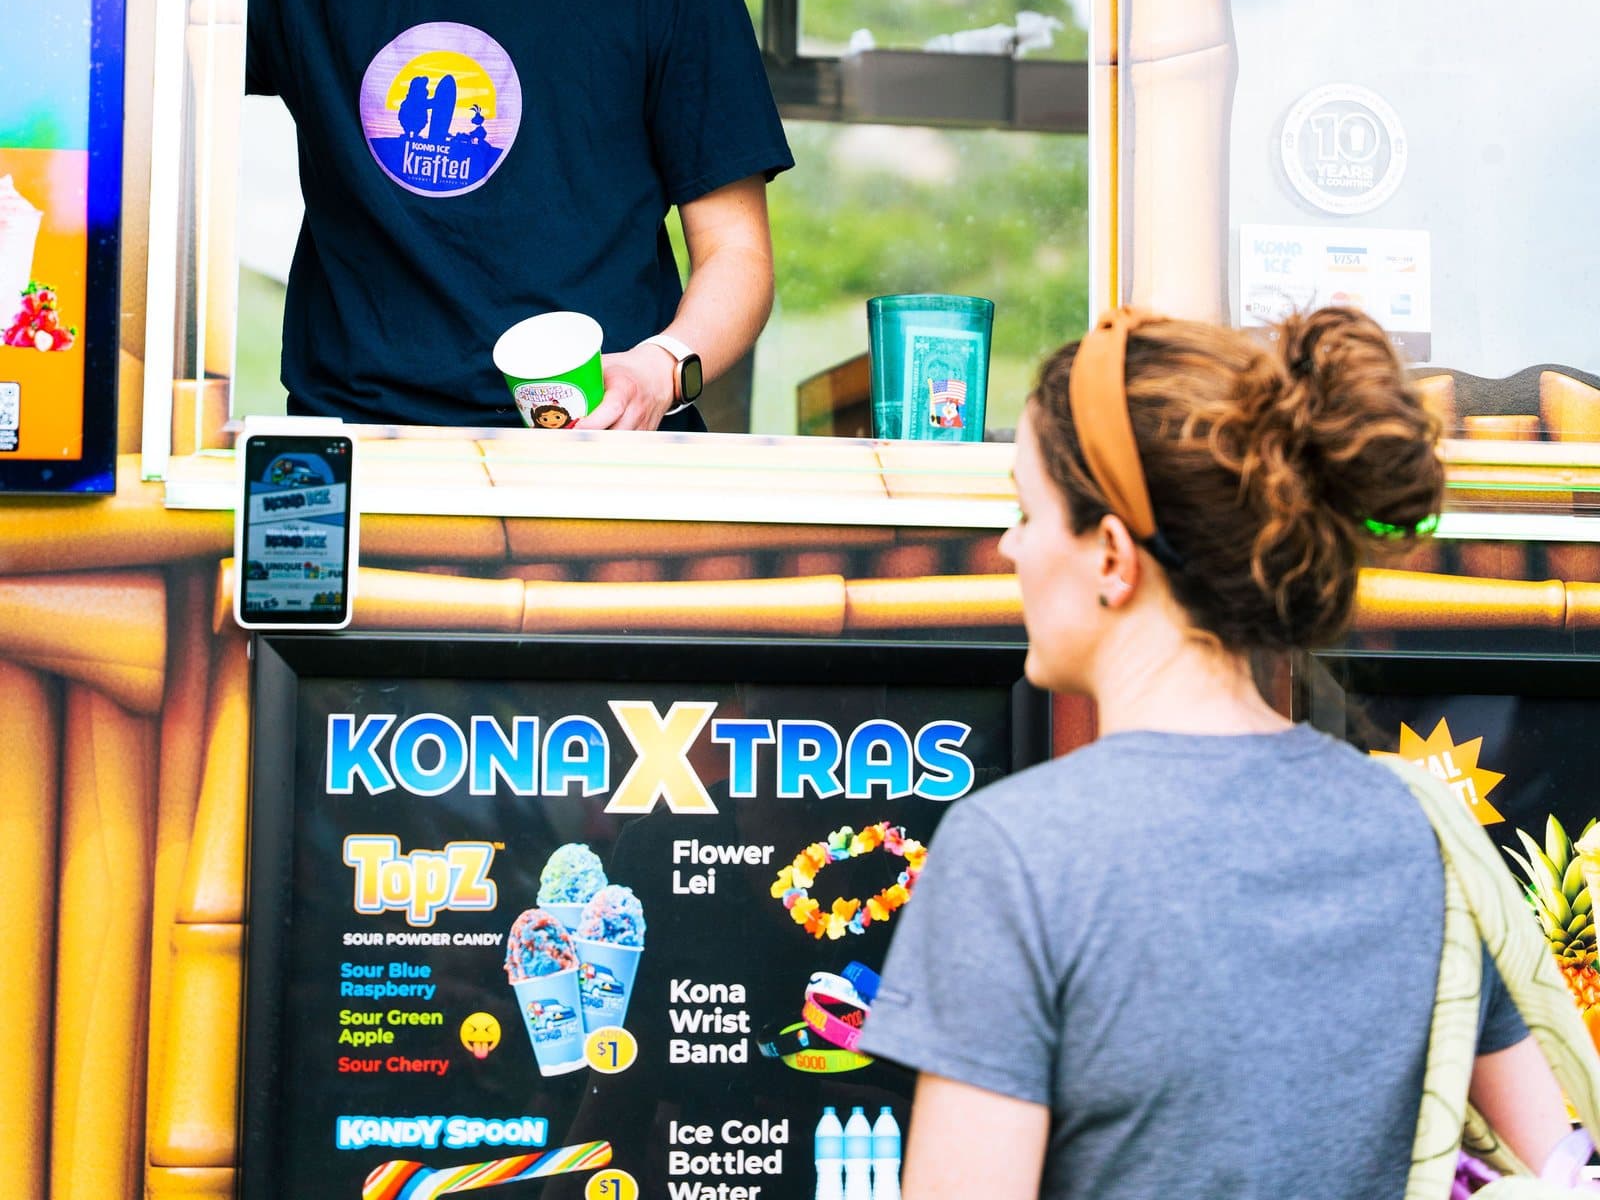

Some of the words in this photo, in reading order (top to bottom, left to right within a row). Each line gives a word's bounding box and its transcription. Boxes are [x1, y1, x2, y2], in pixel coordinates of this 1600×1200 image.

[412, 142, 435, 152] KONA
[436, 145, 450, 154] ICE
[1310, 113, 1381, 161] 10
[1314, 163, 1374, 178] YEARS
[1333, 254, 1361, 265] VISA
[672, 839, 775, 865] Flower
[344, 836, 495, 925] TopZ
[672, 868, 716, 895] Lei
[342, 933, 383, 947] SOUR
[386, 933, 451, 947] POWDER
[452, 933, 504, 947] CANDY
[340, 962, 384, 979] Sour
[388, 962, 431, 979] Blue
[340, 981, 436, 1000] Raspberry
[669, 979, 746, 1004] Kona
[338, 1009, 383, 1026] Sour
[387, 1009, 443, 1026] Green
[668, 1008, 751, 1034] Wrist
[338, 1028, 395, 1047] Apple
[596, 1041, 619, 1068] $1
[668, 1038, 749, 1064] Band
[338, 1056, 382, 1074] Sour
[385, 1056, 450, 1076] Cherry
[337, 1116, 444, 1148] KANDY
[444, 1116, 548, 1147] SPOON
[668, 1119, 714, 1145] Ice
[721, 1118, 790, 1145] Cold
[668, 1149, 784, 1175] Bottled
[667, 1180, 761, 1200] Water
